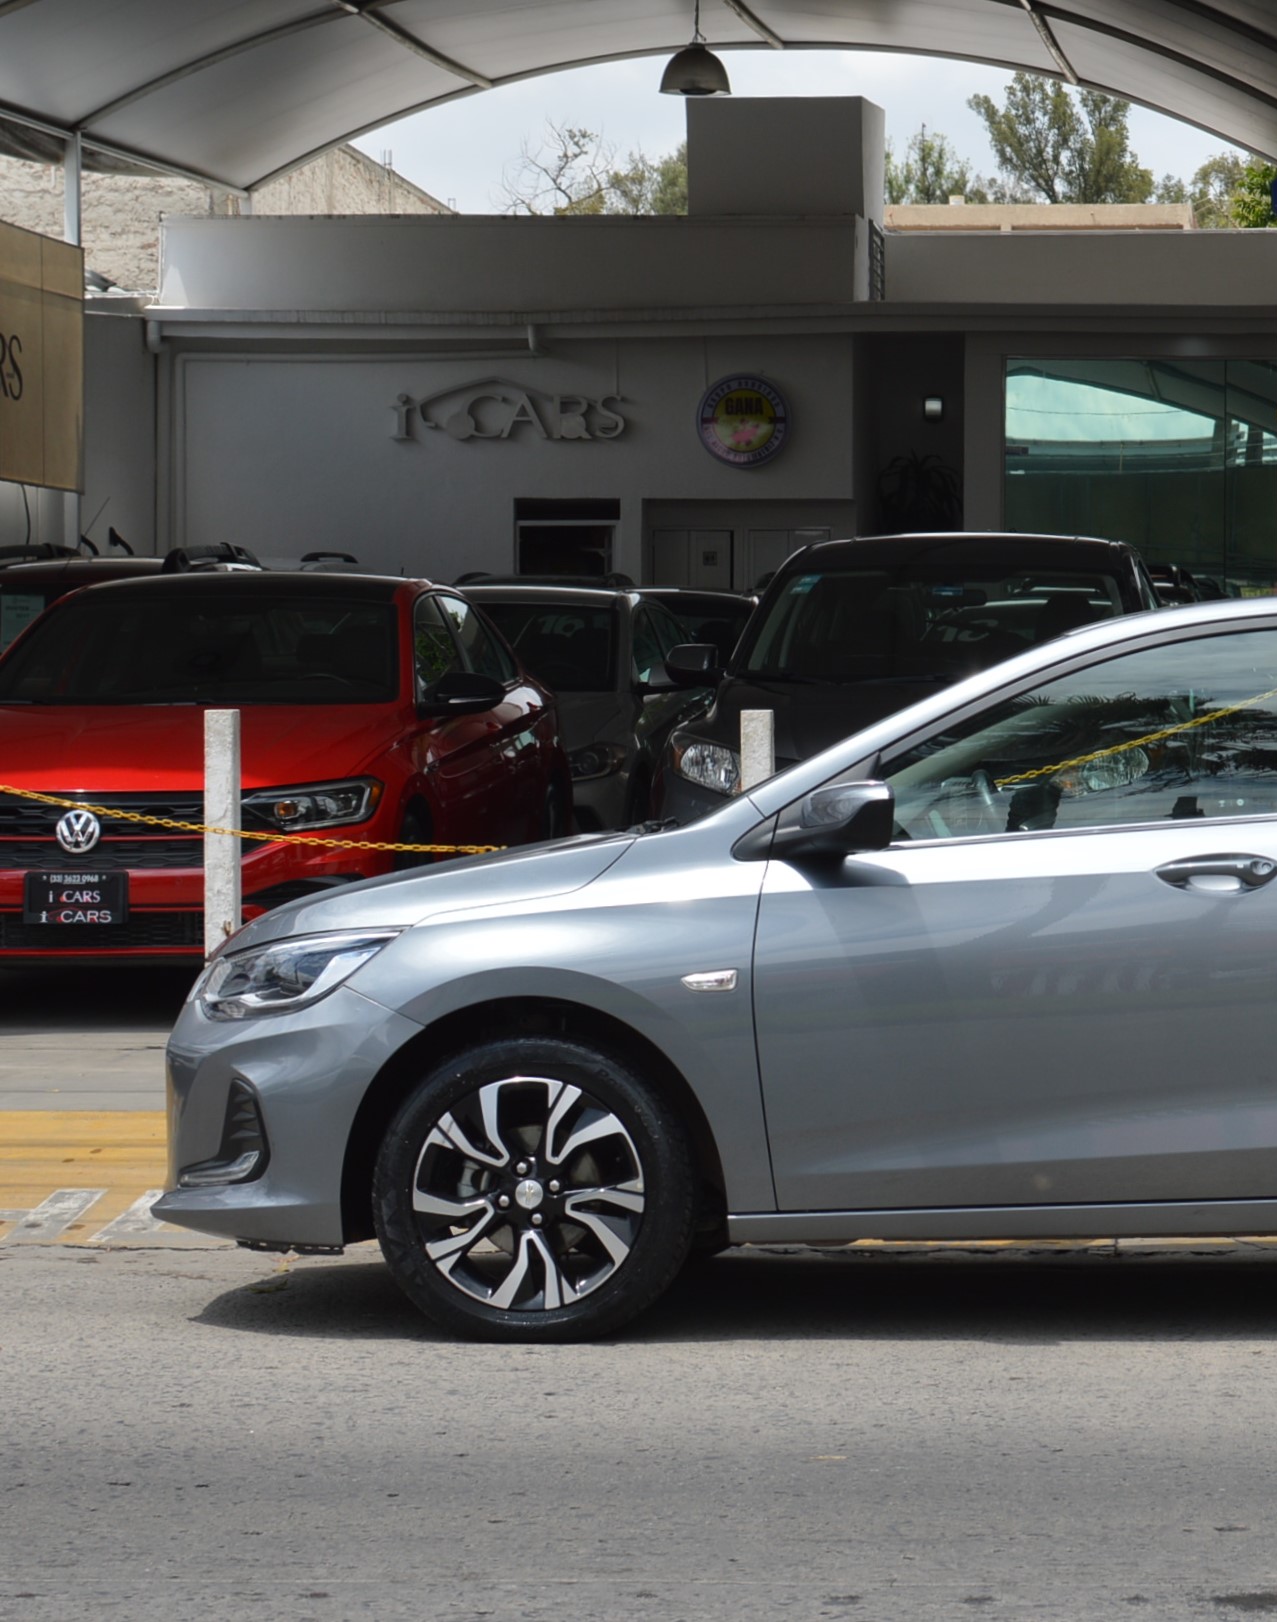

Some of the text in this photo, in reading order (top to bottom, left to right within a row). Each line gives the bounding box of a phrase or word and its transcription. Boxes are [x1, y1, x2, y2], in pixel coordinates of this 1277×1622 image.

[725, 397, 764, 415] GANA
[62, 890, 101, 903] CARS
[60, 910, 112, 924] CARS
